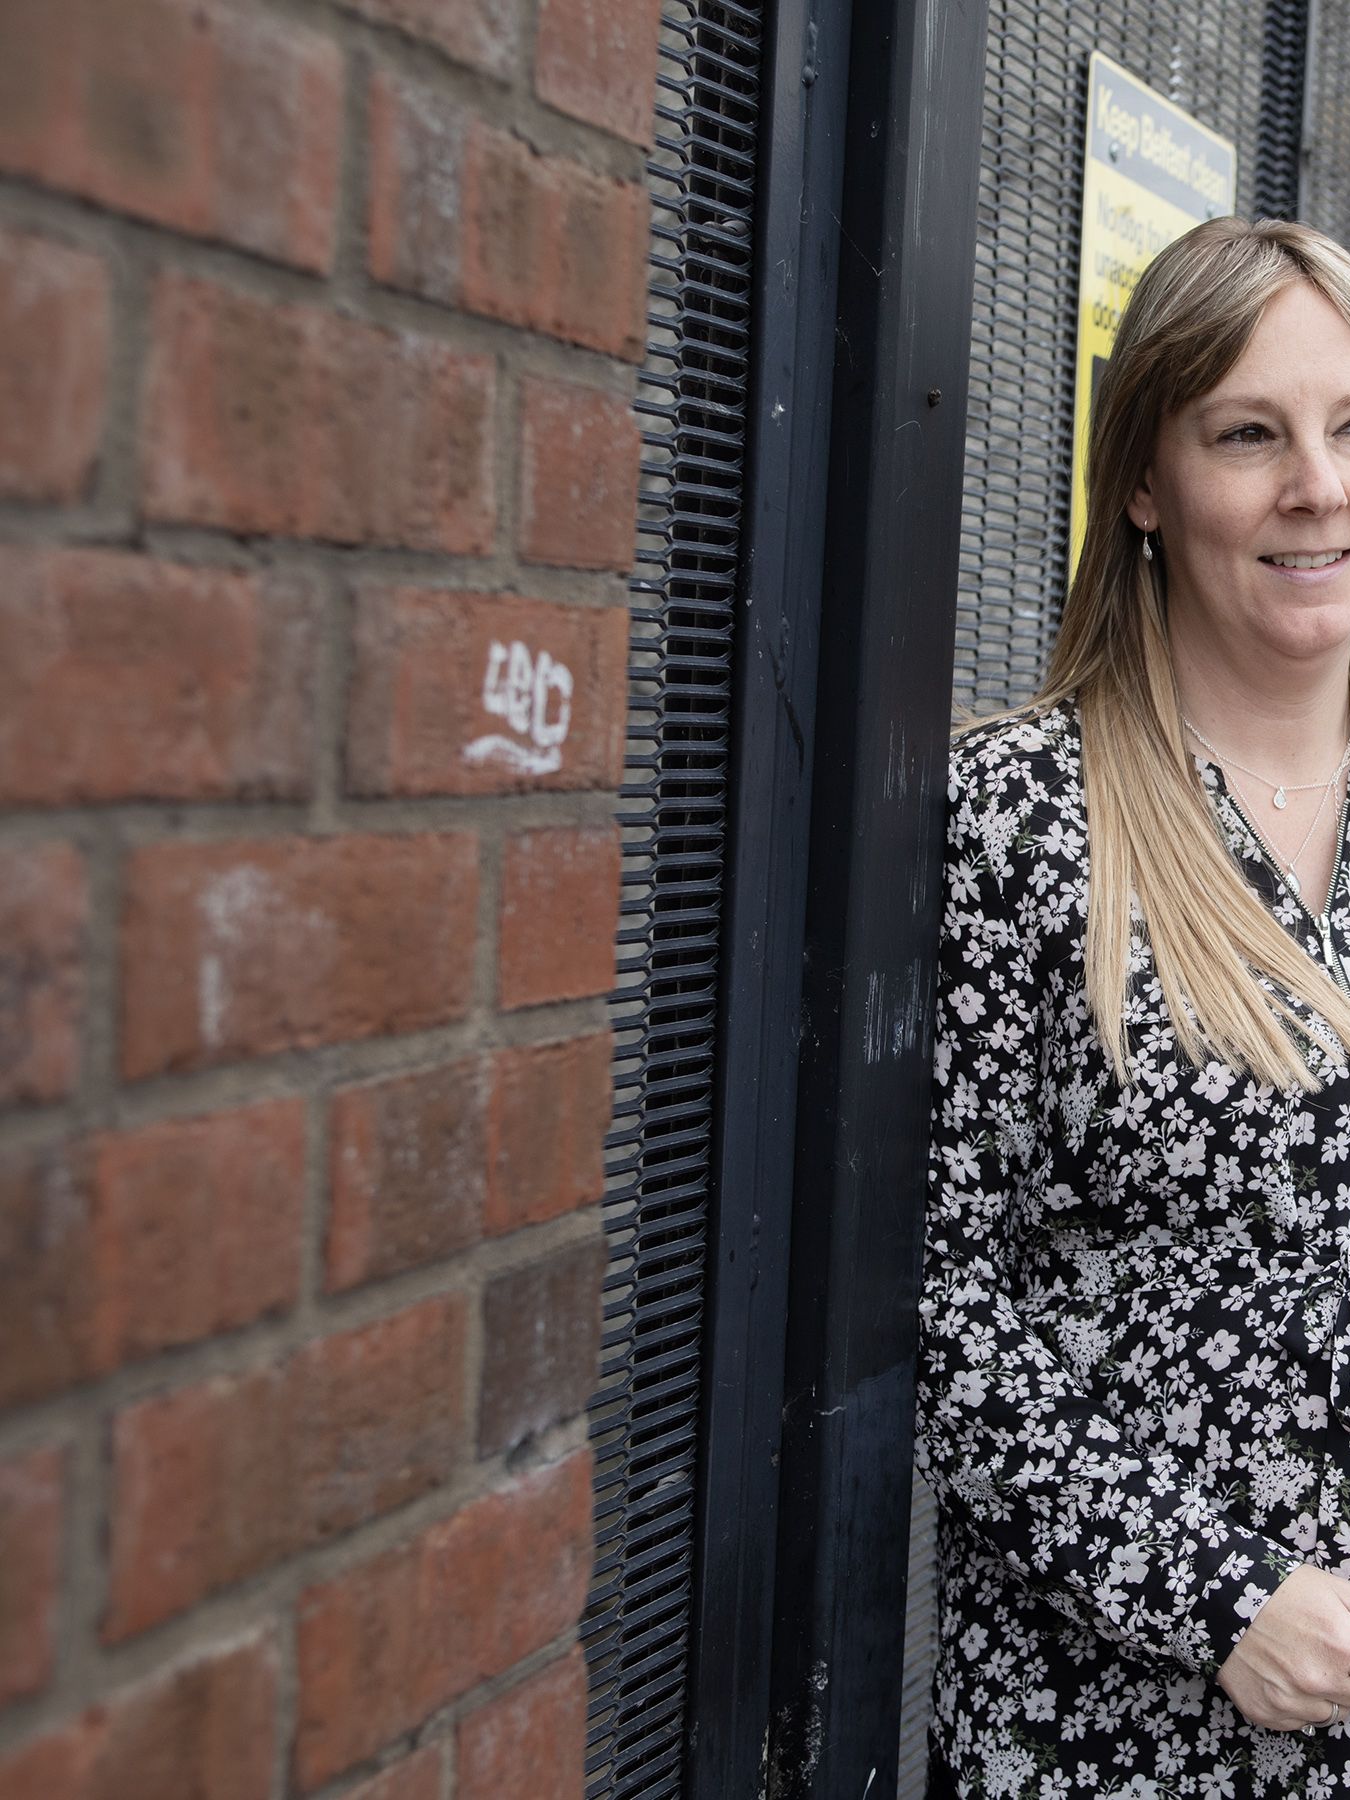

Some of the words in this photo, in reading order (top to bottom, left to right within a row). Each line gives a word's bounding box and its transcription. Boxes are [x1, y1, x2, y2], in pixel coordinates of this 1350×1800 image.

[1097, 84, 1140, 159] Keep
[1140, 113, 1191, 184] Belfast
[1191, 153, 1227, 206] clean
